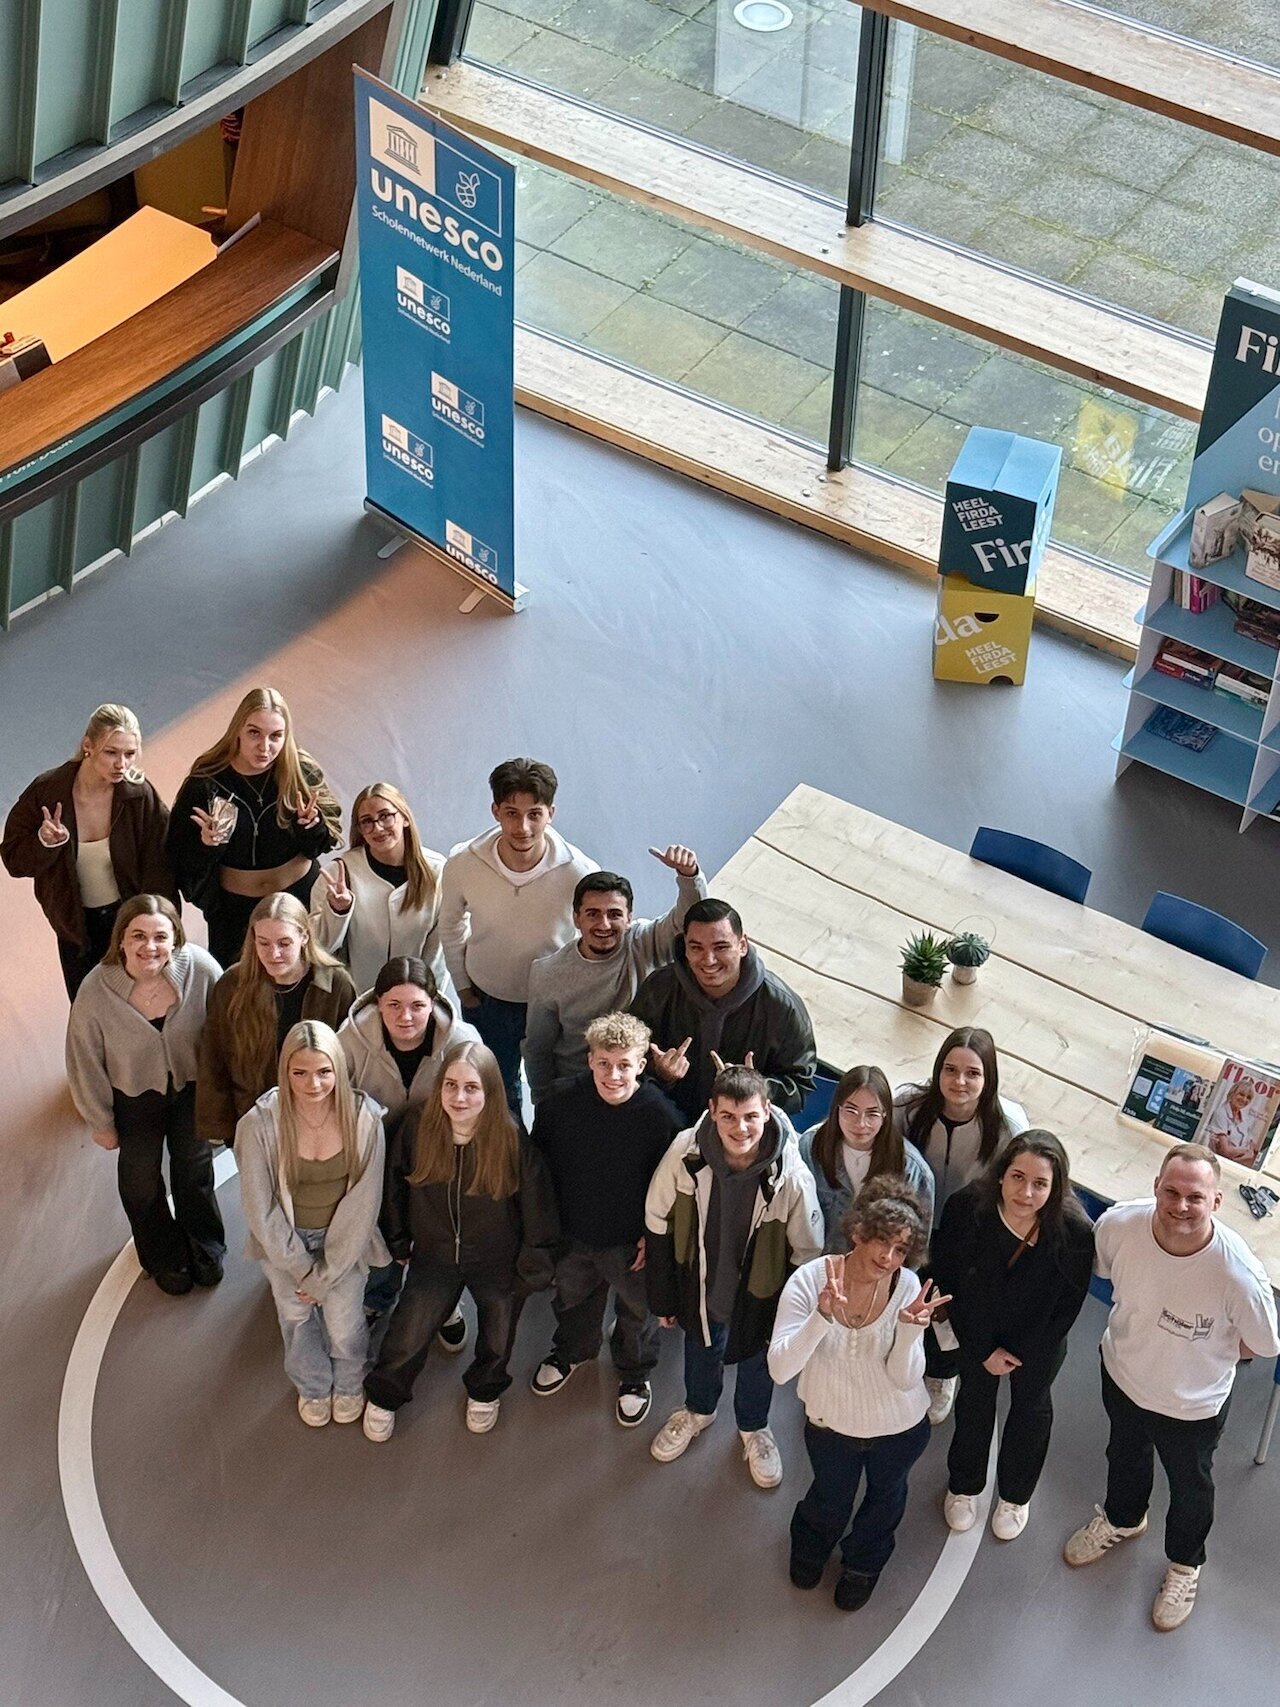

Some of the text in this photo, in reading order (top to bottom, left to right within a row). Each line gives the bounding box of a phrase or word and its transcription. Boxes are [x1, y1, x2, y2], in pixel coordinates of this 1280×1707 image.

[371, 168, 504, 272] unesco
[372, 205, 502, 297] Scholennetwerk Nederland
[397, 293, 451, 335] unesco
[432, 397, 485, 439] unesco
[382, 438, 434, 481] unesco
[952, 497, 989, 512] HEEL
[957, 506, 999, 522] FIRDA
[962, 515, 1003, 532] LEEST
[446, 544, 498, 585] unesco
[965, 641, 1002, 658] HEEL
[970, 647, 1012, 666] FIRDA
[976, 653, 1017, 674] LEEST
